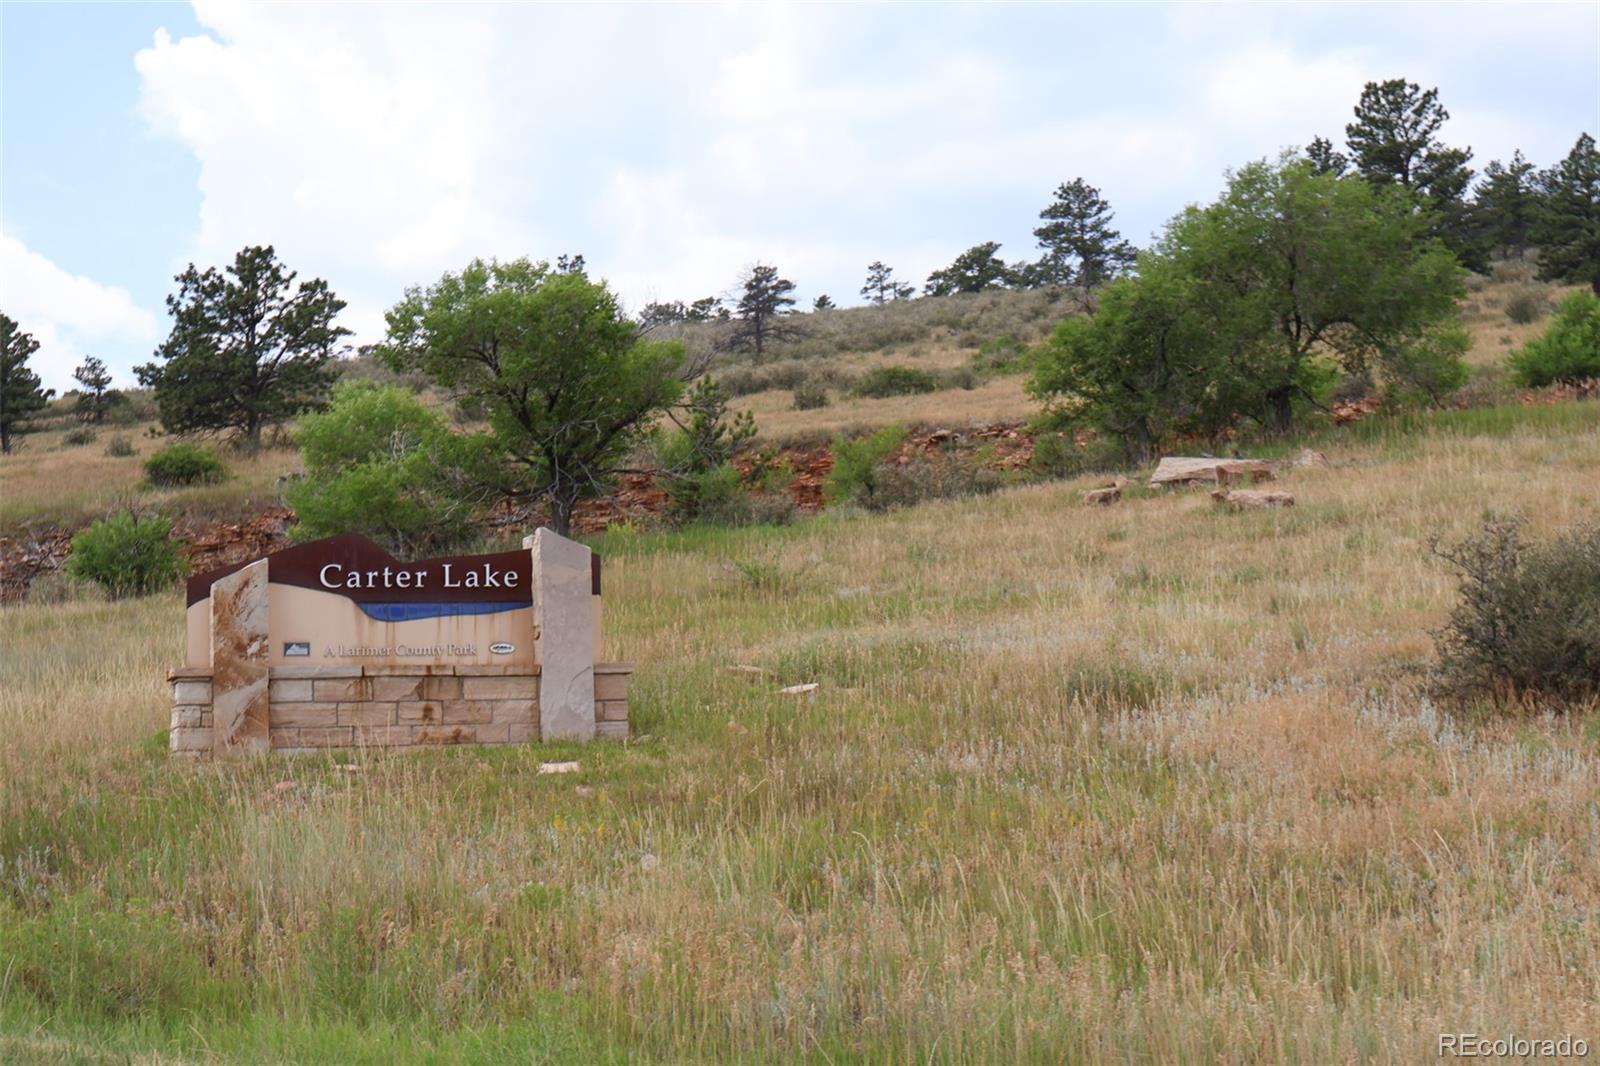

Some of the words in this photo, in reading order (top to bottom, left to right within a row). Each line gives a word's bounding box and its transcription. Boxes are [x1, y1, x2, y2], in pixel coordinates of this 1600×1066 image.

[319, 563, 428, 589] Carter
[442, 563, 519, 588] Lake
[323, 645, 336, 658] A
[338, 644, 392, 657] Larimer
[394, 644, 443, 659] County
[447, 643, 478, 657] Park
